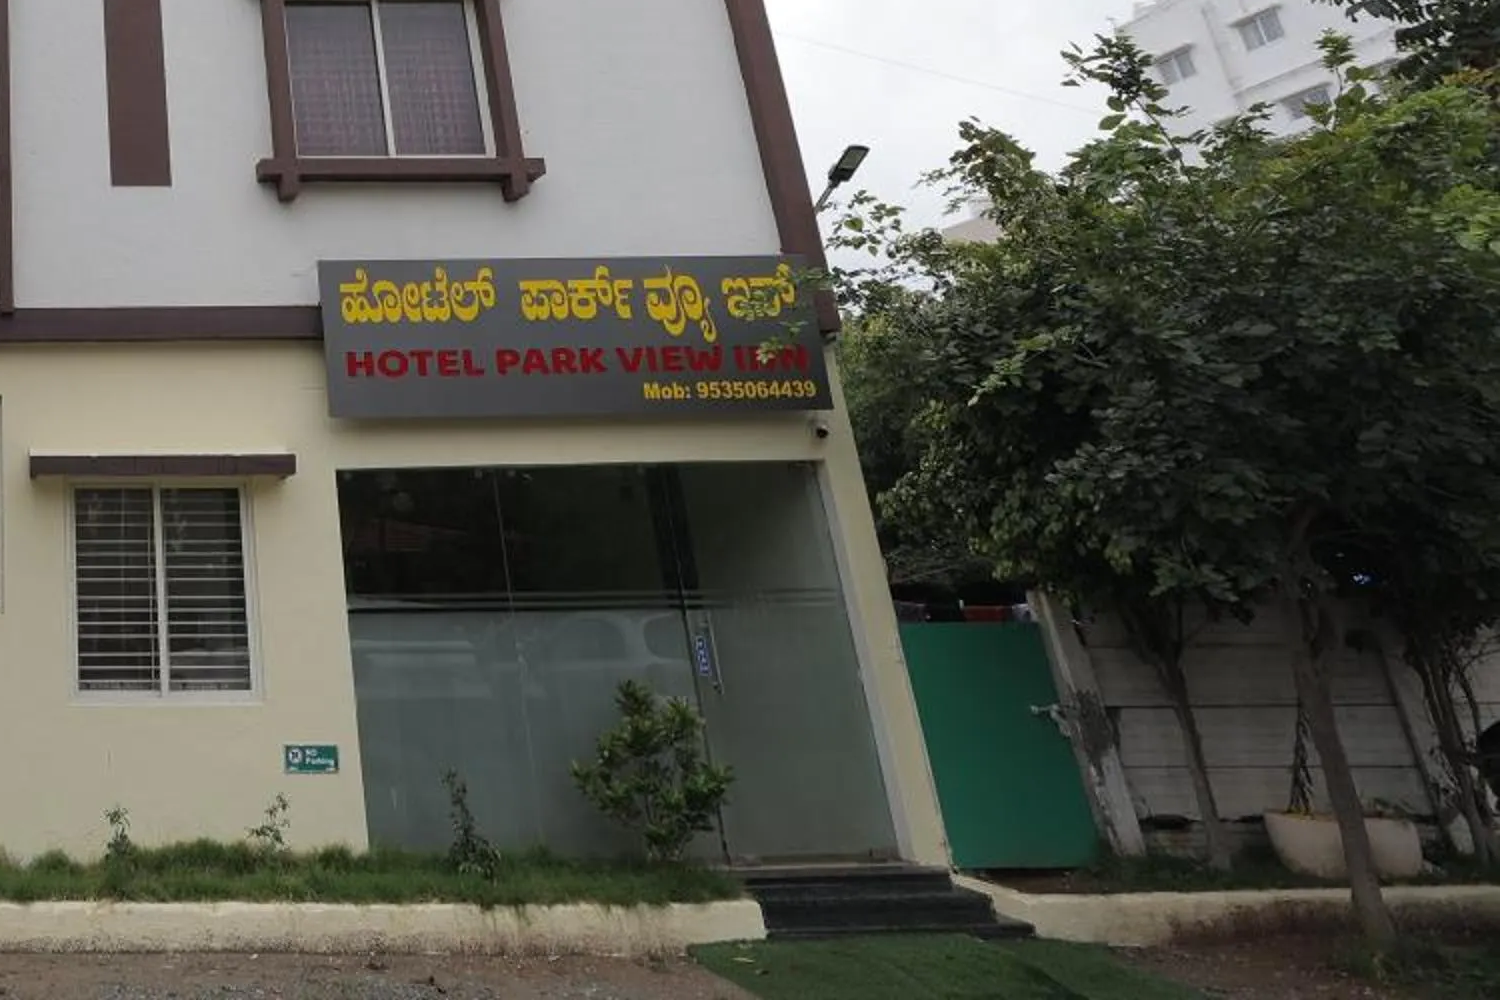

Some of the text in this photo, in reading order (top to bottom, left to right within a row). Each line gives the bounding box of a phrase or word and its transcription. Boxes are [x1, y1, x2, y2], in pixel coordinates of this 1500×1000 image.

[339, 267, 496, 323] ಹೋಟೆಲ್
[519, 265, 633, 321] ಪಾರ್ಕ್
[346, 349, 485, 378] HOTEL
[496, 347, 608, 376] PARK
[614, 344, 724, 374] VIEW
[643, 379, 817, 399] Mob: 9535064439
